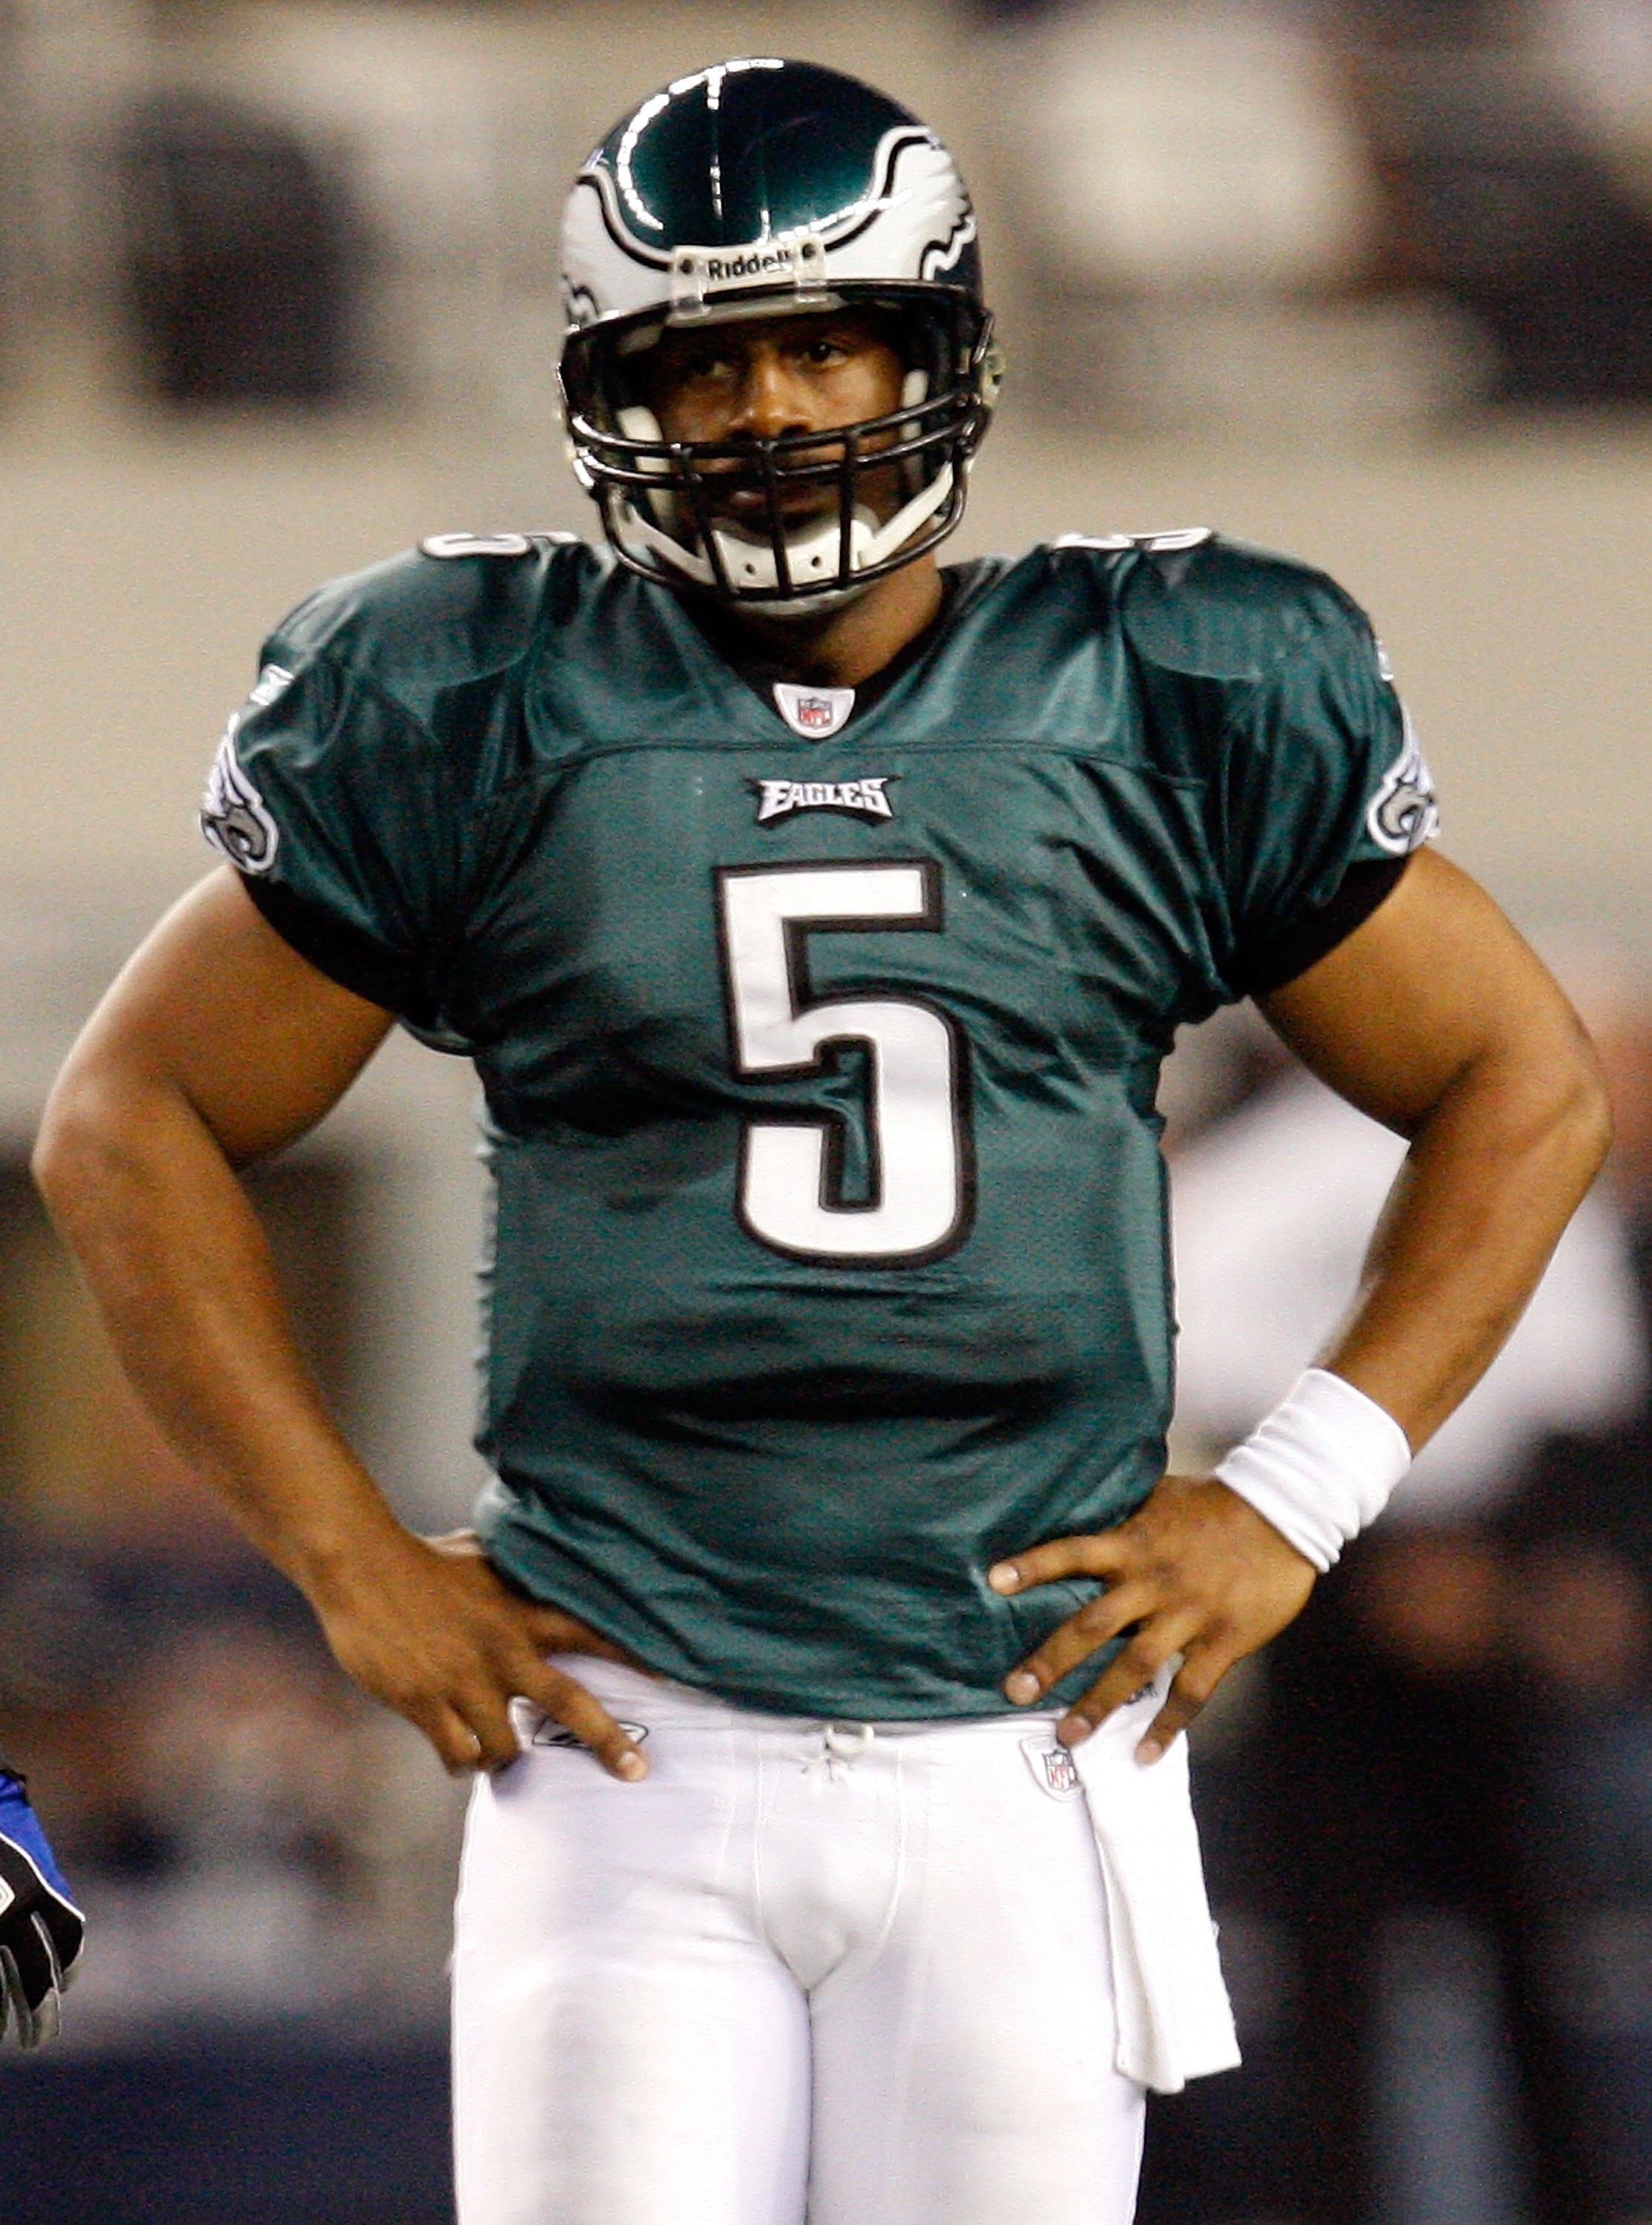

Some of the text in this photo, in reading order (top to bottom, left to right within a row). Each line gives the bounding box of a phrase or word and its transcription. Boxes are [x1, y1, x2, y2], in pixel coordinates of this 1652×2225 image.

[708, 248, 791, 280] Riddell
[756, 777, 895, 822] EAGLES
[720, 863, 969, 1260] 5
